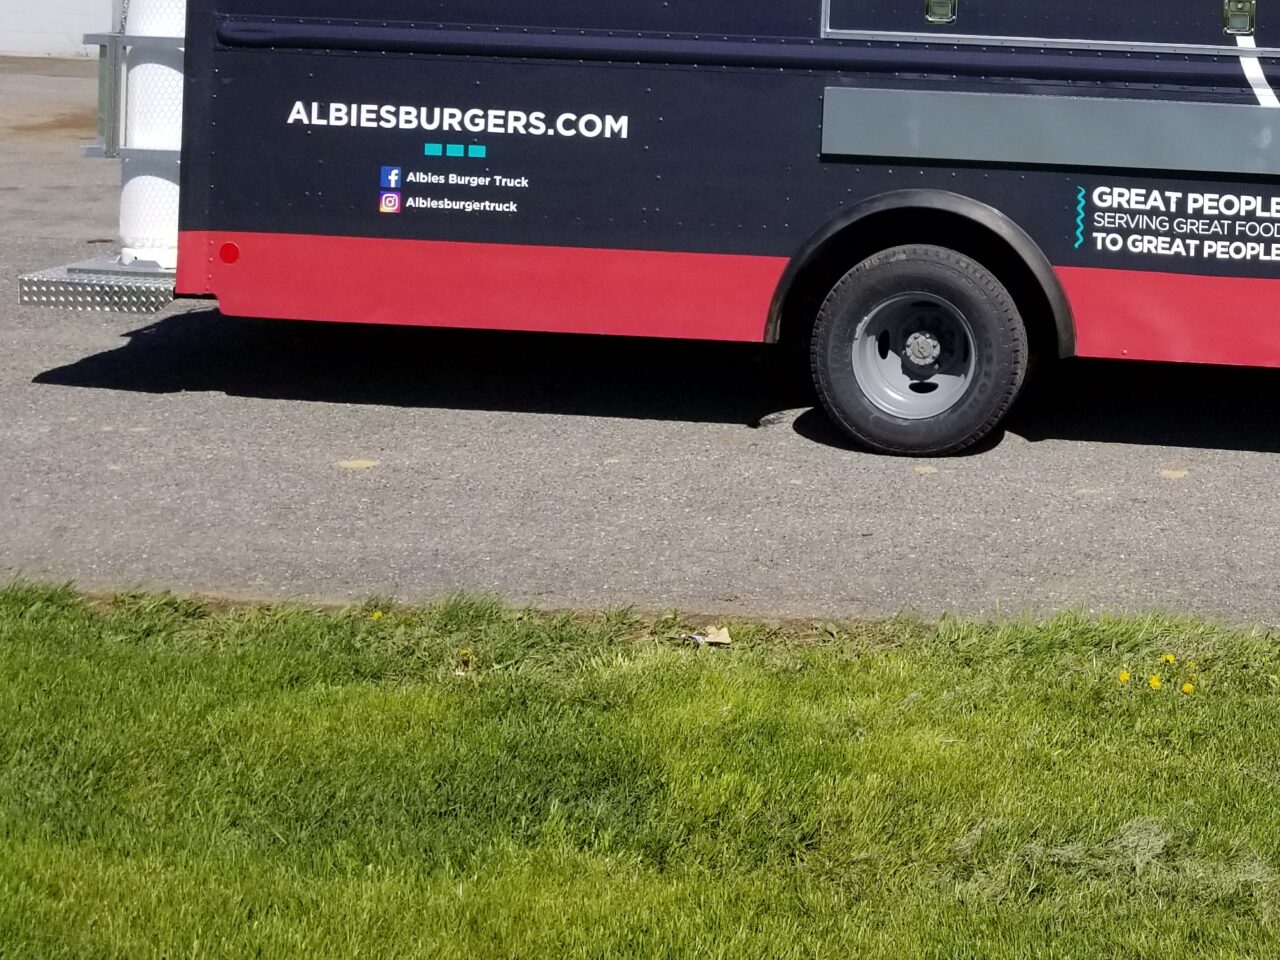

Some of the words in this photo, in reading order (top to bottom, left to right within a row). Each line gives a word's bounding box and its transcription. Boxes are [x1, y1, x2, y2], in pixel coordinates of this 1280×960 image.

[287, 101, 629, 139] ALBIESBURGERS.COM
[406, 171, 445, 184] Albies
[448, 173, 491, 187] Burger
[494, 175, 529, 188] Truck
[405, 196, 518, 213] Albiesburgertruck
[1092, 186, 1183, 213] GREAT
[1093, 211, 1170, 231] SERVING
[1173, 217, 1232, 235] GREAT
[1092, 232, 1124, 252] TO
[1126, 234, 1200, 258] GREAT
